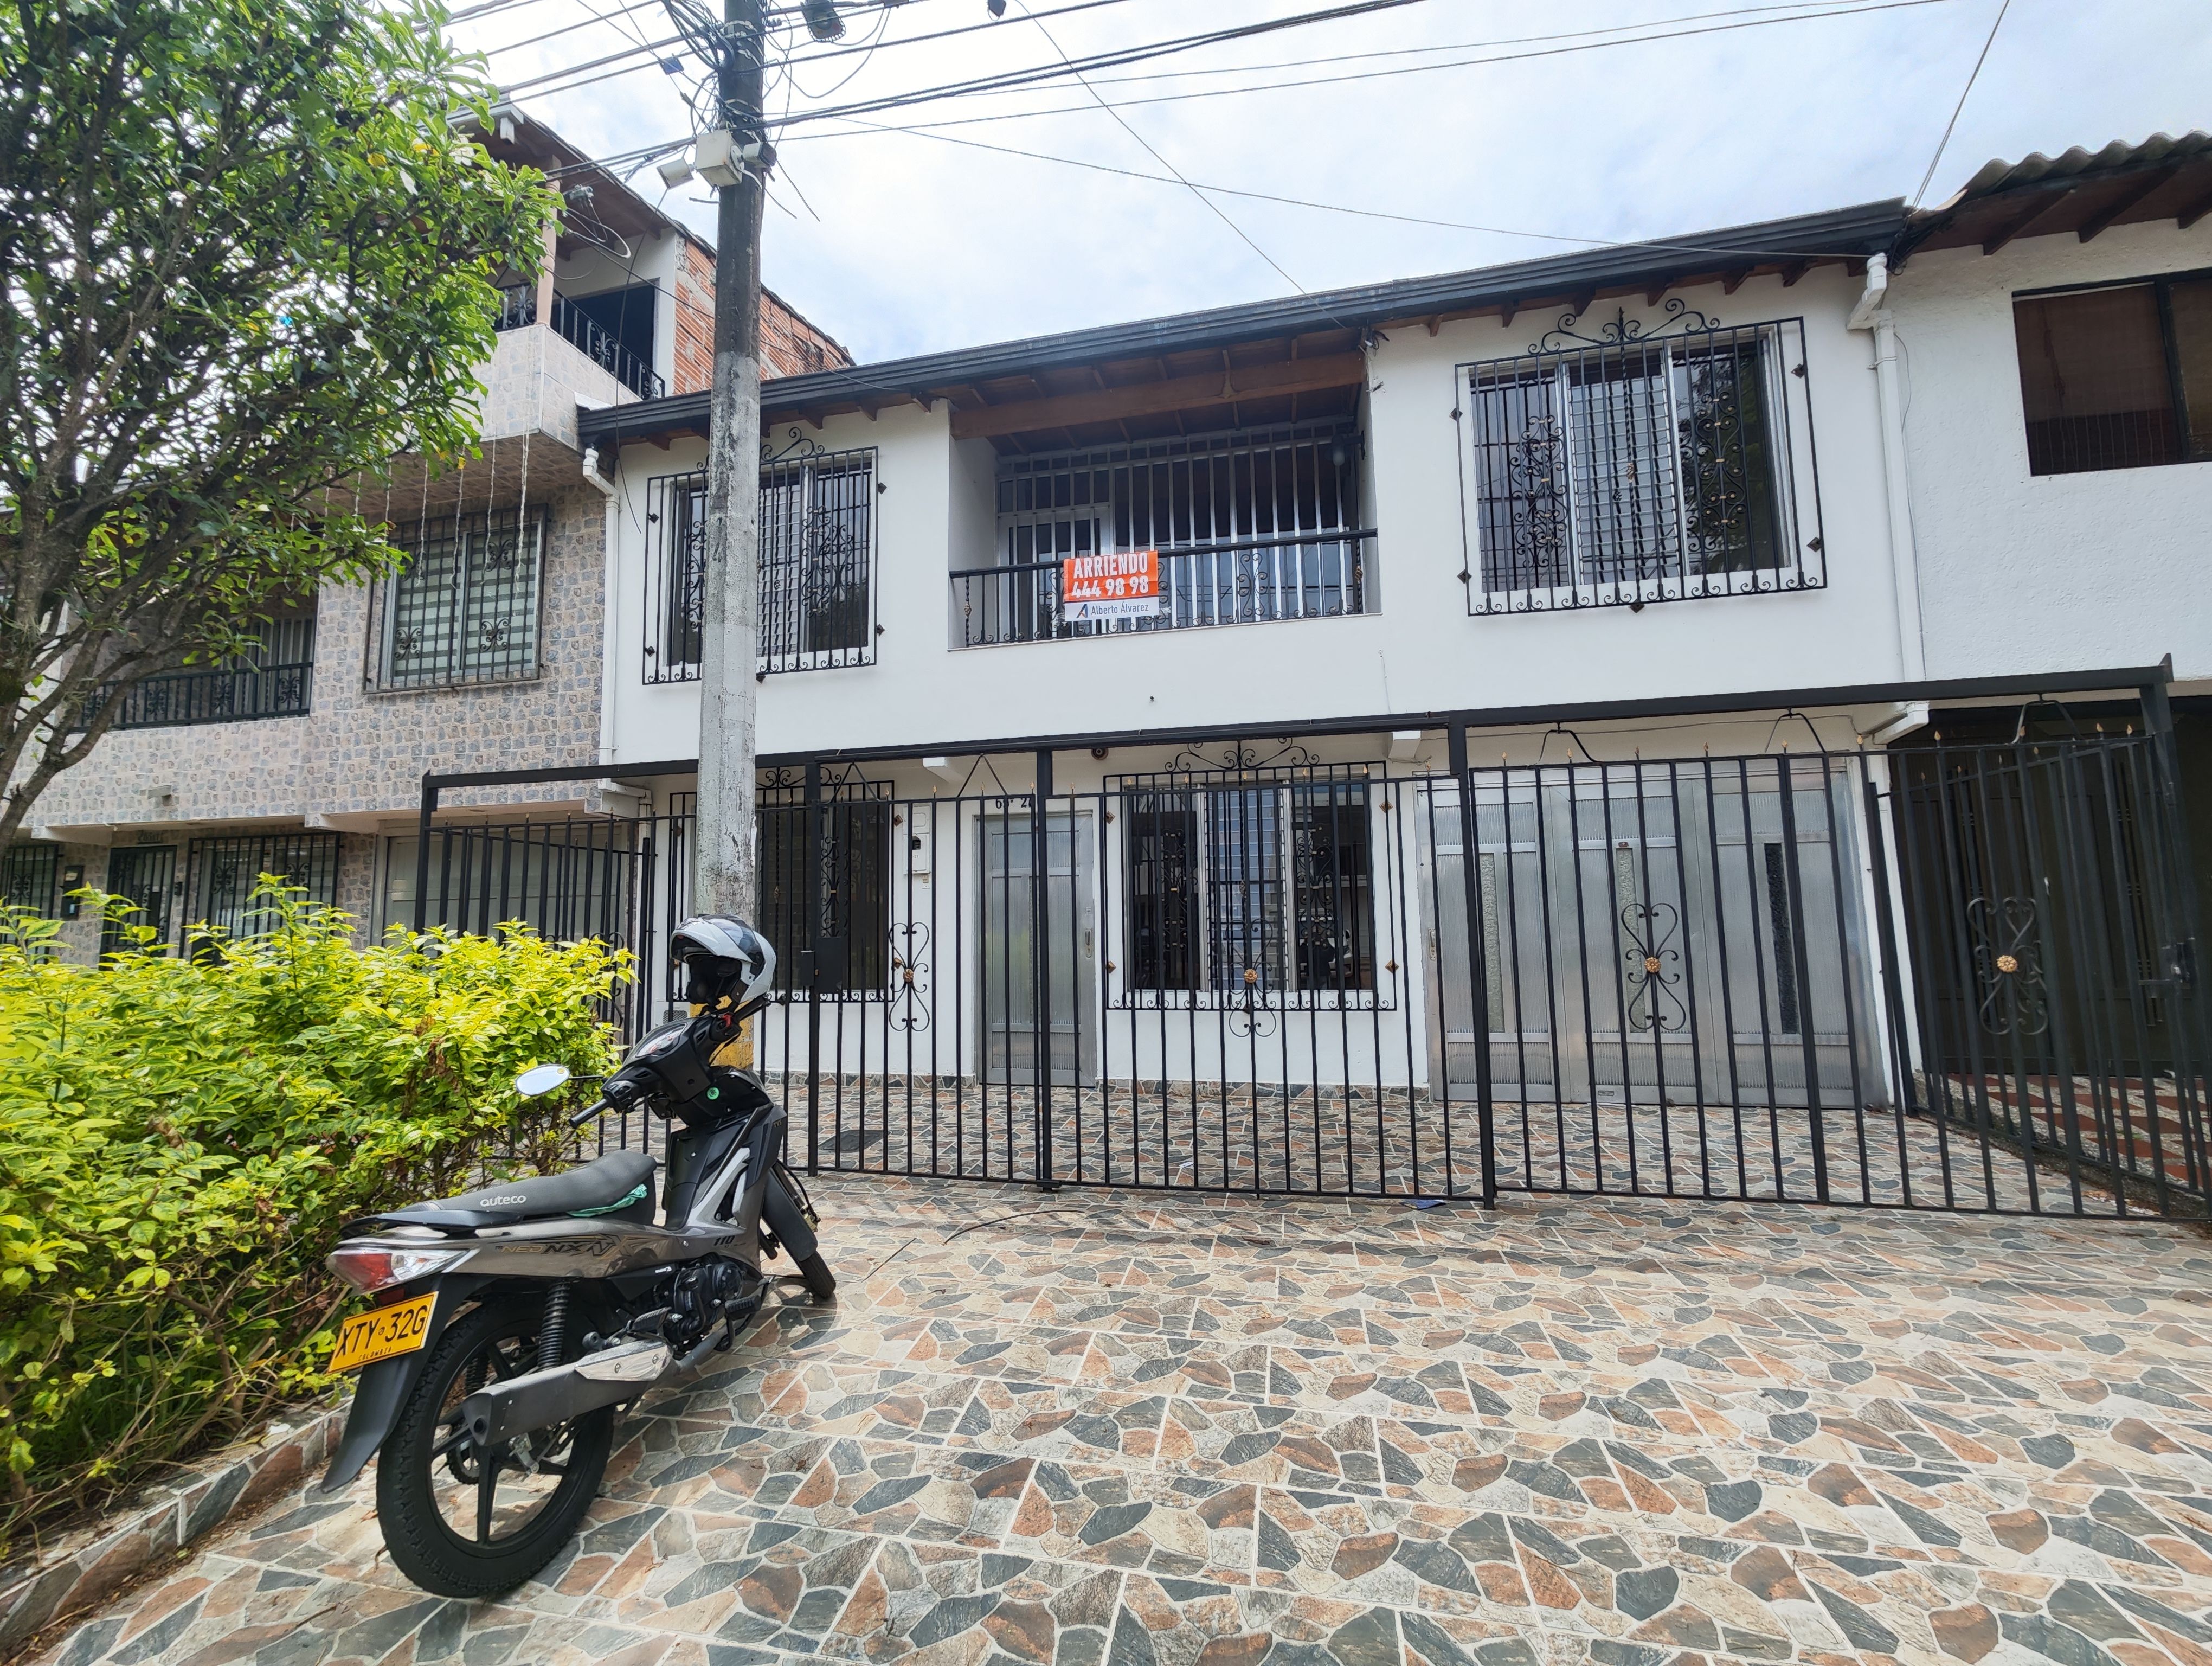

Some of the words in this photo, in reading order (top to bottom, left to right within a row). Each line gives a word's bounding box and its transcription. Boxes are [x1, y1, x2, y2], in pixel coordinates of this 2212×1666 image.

[1073, 552, 1148, 579] ARRIENDO
[1071, 580, 1101, 598] 444
[1105, 578, 1124, 596] 98
[1129, 575, 1149, 594] 98
[1091, 605, 1118, 615] Alberto
[1120, 601, 1149, 613] Álvarez
[480, 1195, 526, 1207] auteco
[713, 1235, 735, 1246] 110
[335, 1317, 381, 1359] XTY
[385, 1305, 428, 1342] 32G
